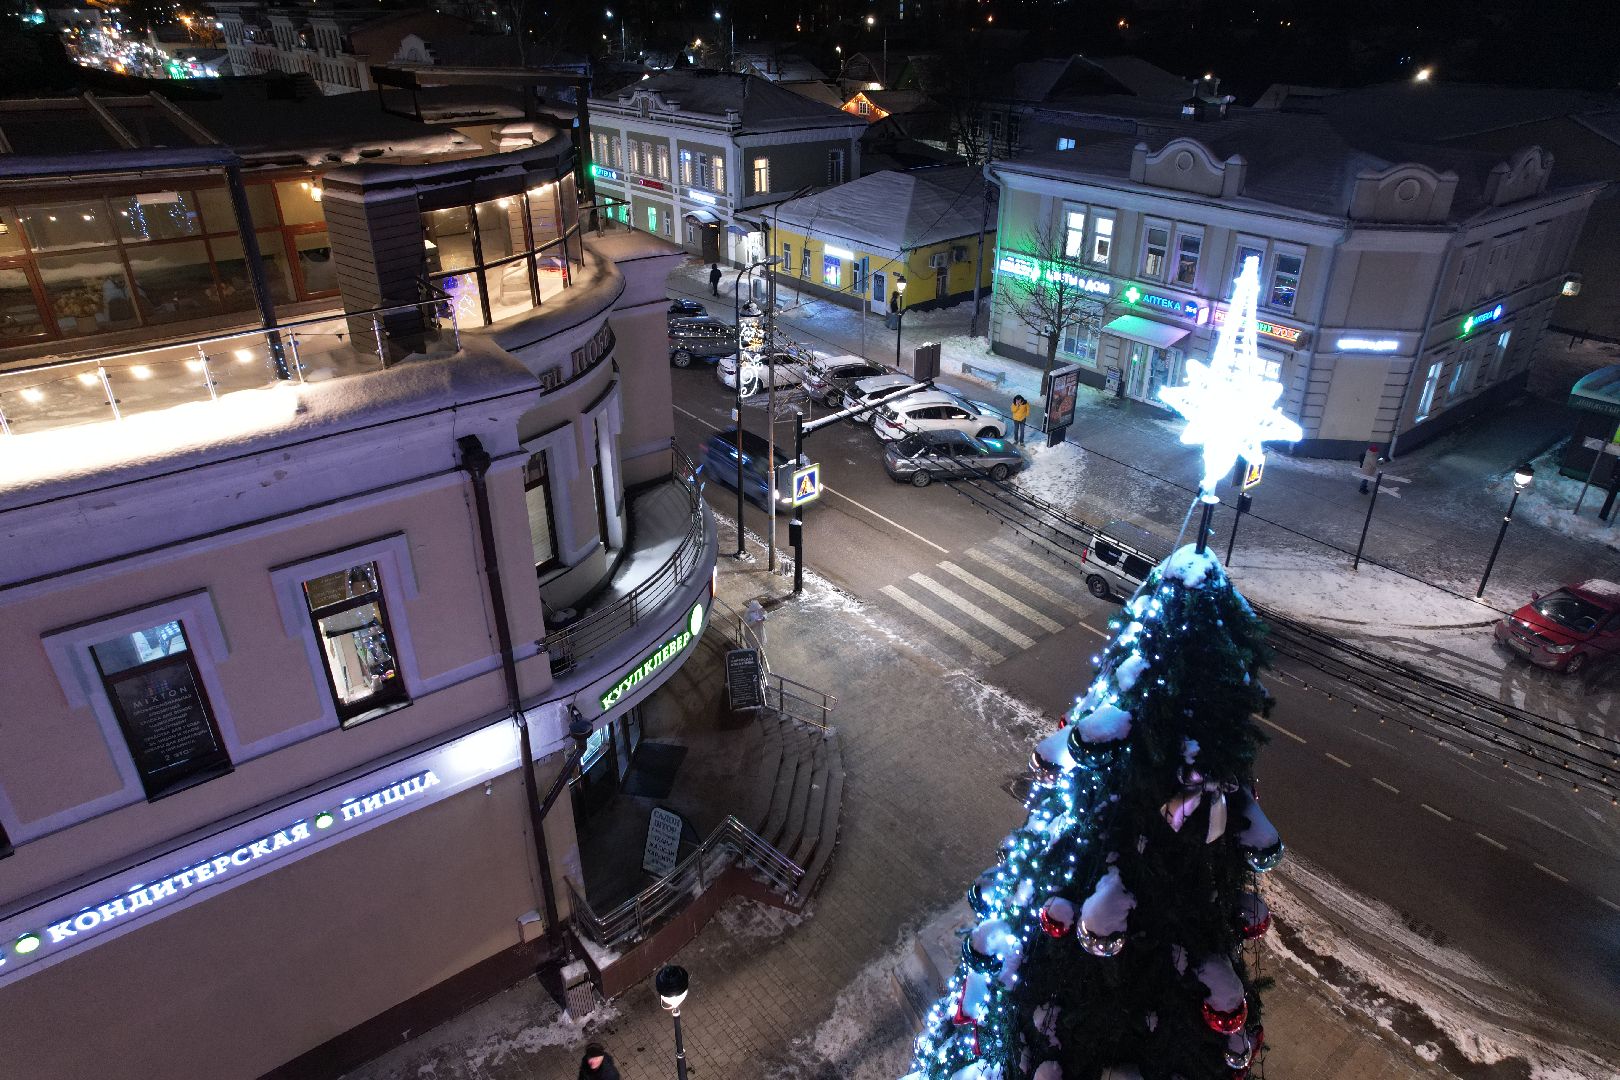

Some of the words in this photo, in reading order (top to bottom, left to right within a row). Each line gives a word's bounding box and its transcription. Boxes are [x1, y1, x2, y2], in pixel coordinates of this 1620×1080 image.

[1143, 294, 1181, 310] АПТЕКА
[133, 686, 187, 709] MIXTON
[47, 821, 312, 942] КОНДИТЕРСКАЯ
[341, 769, 440, 822] ПИЦЦА
